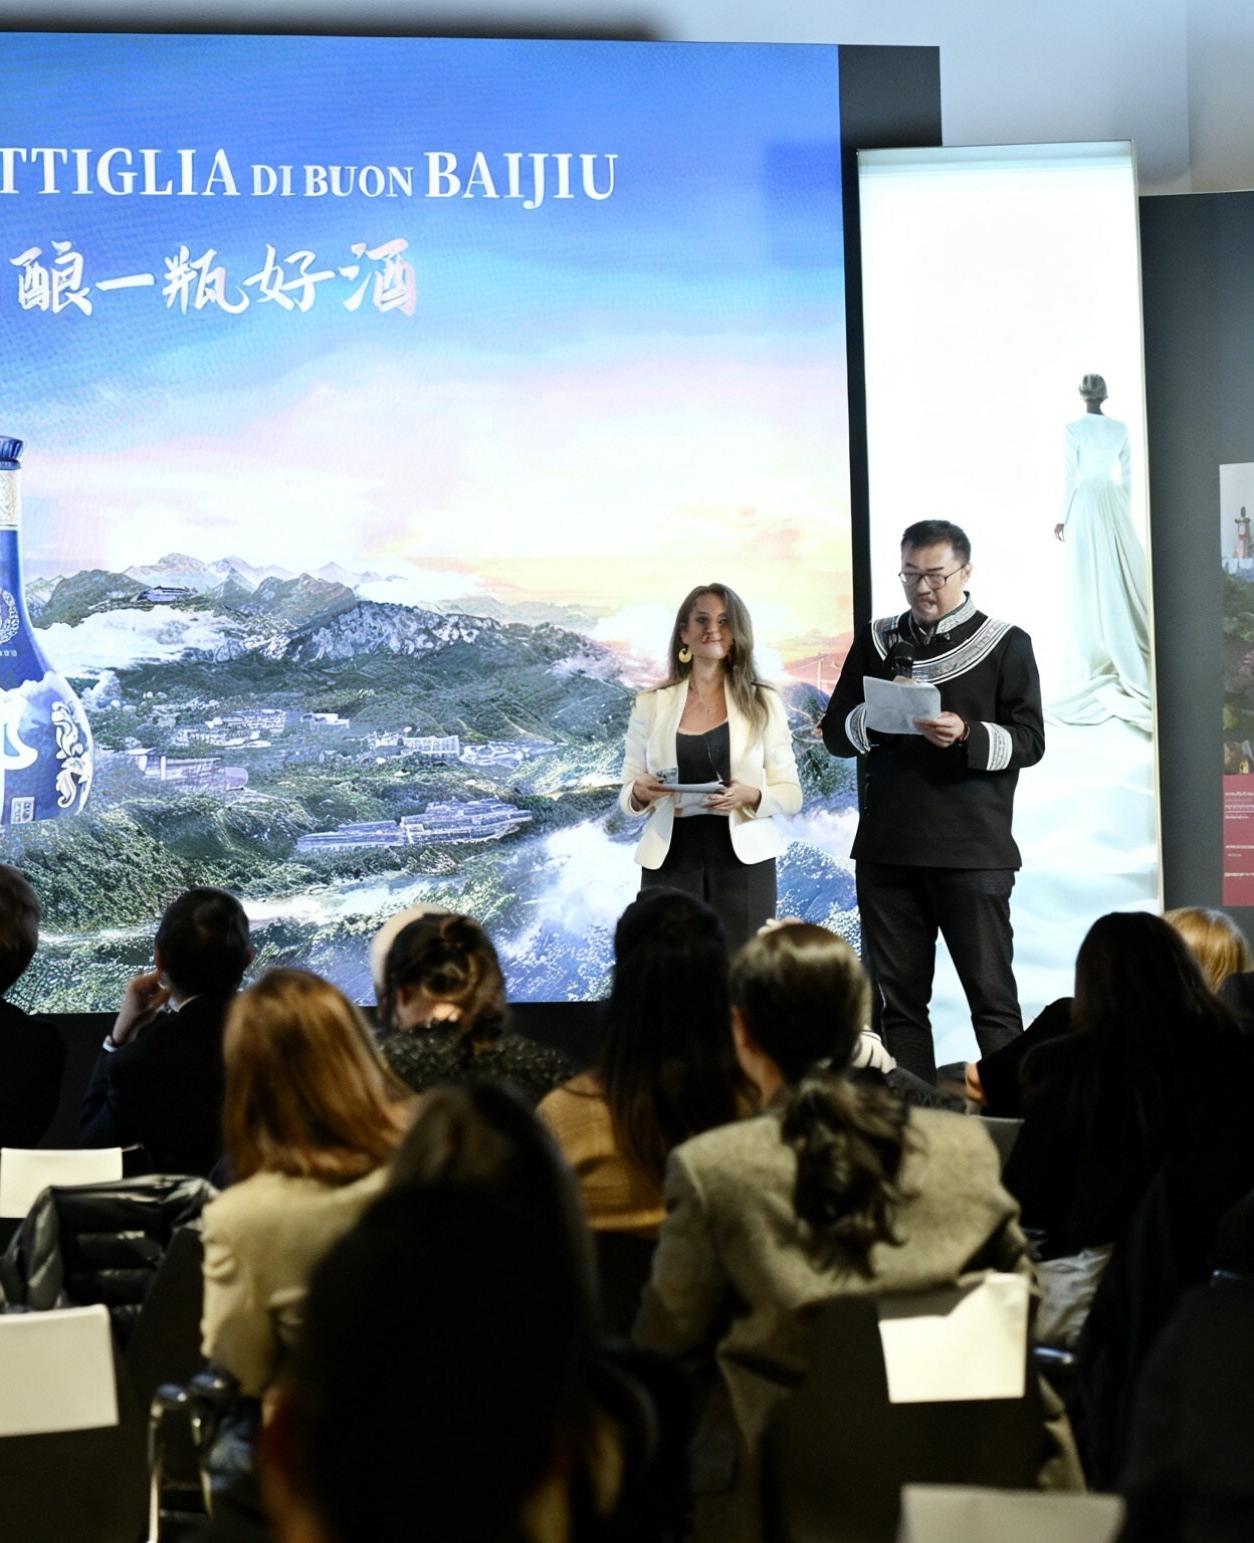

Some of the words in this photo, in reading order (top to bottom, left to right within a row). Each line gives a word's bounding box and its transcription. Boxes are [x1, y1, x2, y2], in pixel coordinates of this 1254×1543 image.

[250, 163, 295, 197] DI
[303, 164, 415, 198] BUON
[423, 150, 620, 210] BAIJIU
[8, 236, 418, 318] 酿一瓶好酒
